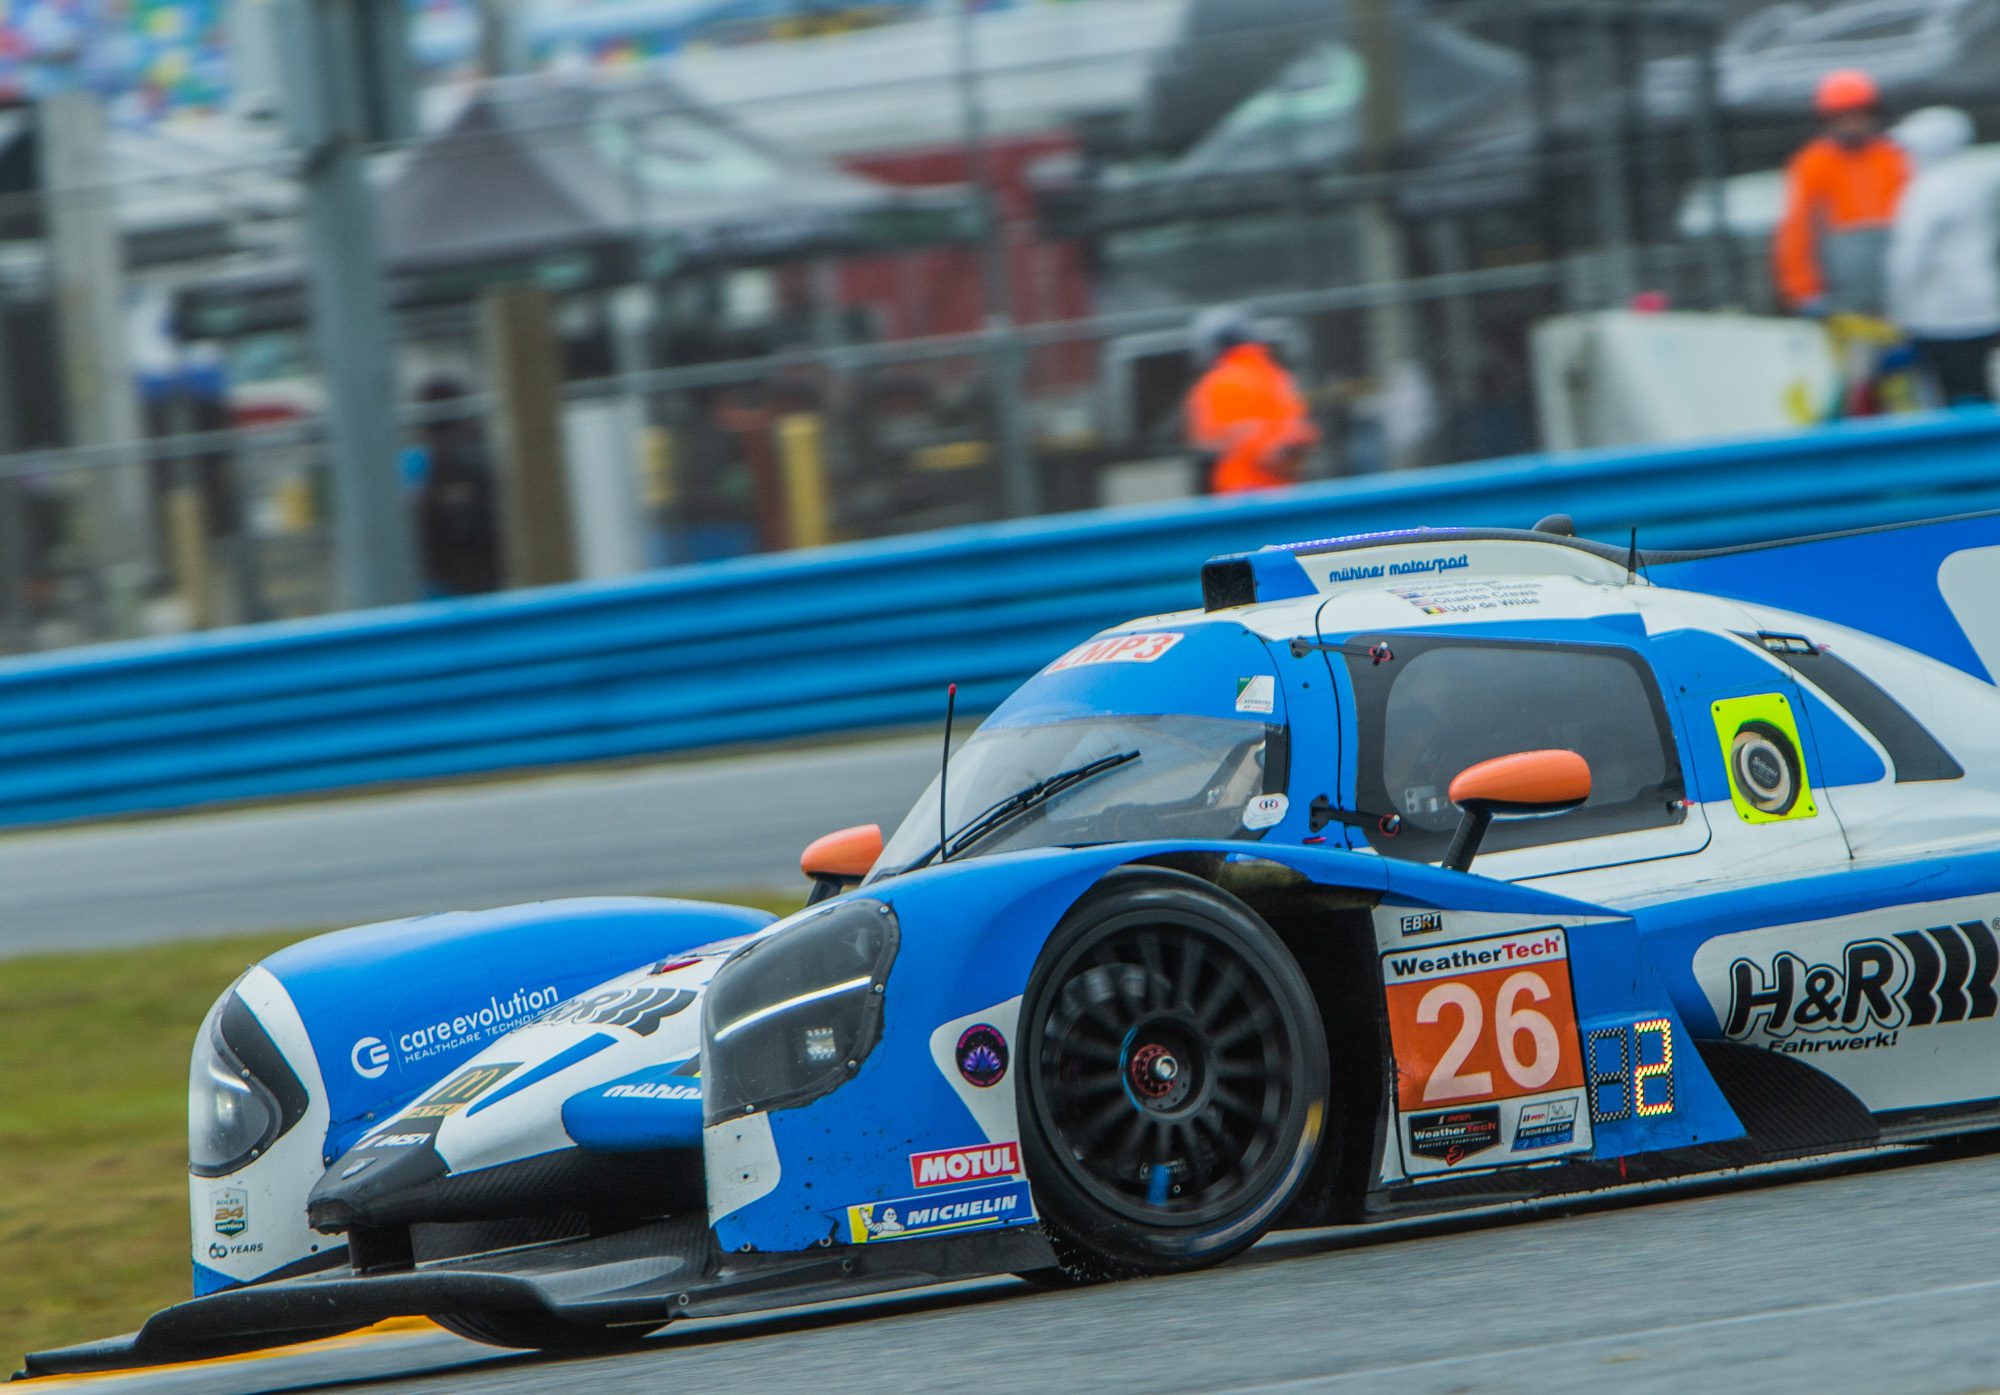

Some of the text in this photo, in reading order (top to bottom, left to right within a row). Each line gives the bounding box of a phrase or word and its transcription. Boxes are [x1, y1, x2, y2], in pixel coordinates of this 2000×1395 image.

[1329, 564, 1386, 583] mühlner
[1389, 553, 1470, 574] motorsport
[1433, 593, 1488, 605] Charles
[1445, 596, 1541, 615] Ugo de Wilde
[1054, 634, 1175, 671] LMP3
[1402, 911, 1441, 933] EBRT
[1725, 939, 1906, 1038] H&R
[404, 1031, 482, 1064] HEALTHCARE
[1415, 970, 1562, 1104] 26
[1768, 1030, 1899, 1054] Fahrwerk!
[601, 1082, 703, 1100] mühln
[1413, 1121, 1498, 1141] WeatherTech
[918, 1147, 1016, 1184] MOTUL
[215, 1205, 244, 1221] 24
[906, 1194, 1018, 1226] MICHELIN
[231, 1243, 263, 1254] YEARS
